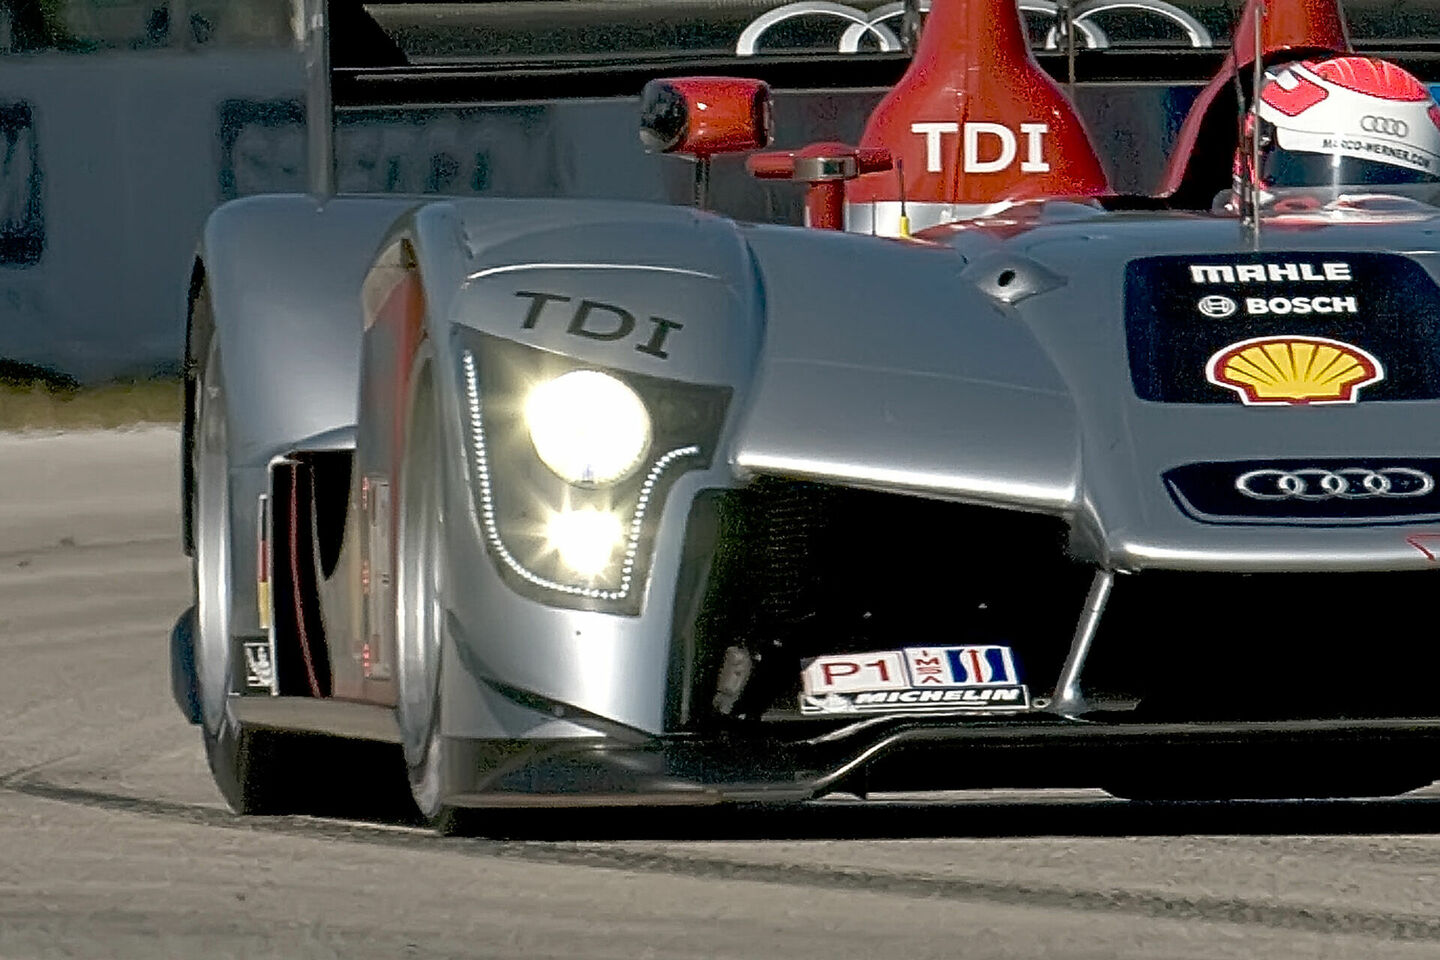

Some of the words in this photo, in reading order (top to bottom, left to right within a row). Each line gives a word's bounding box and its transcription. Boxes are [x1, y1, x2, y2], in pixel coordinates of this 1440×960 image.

[911, 122, 1050, 173] TDI
[1190, 263, 1352, 283] MAHLE
[1245, 296, 1358, 315] BOSCH
[514, 290, 685, 361] TDI
[820, 659, 890, 686] P1
[853, 688, 1020, 705] MICHELIN
